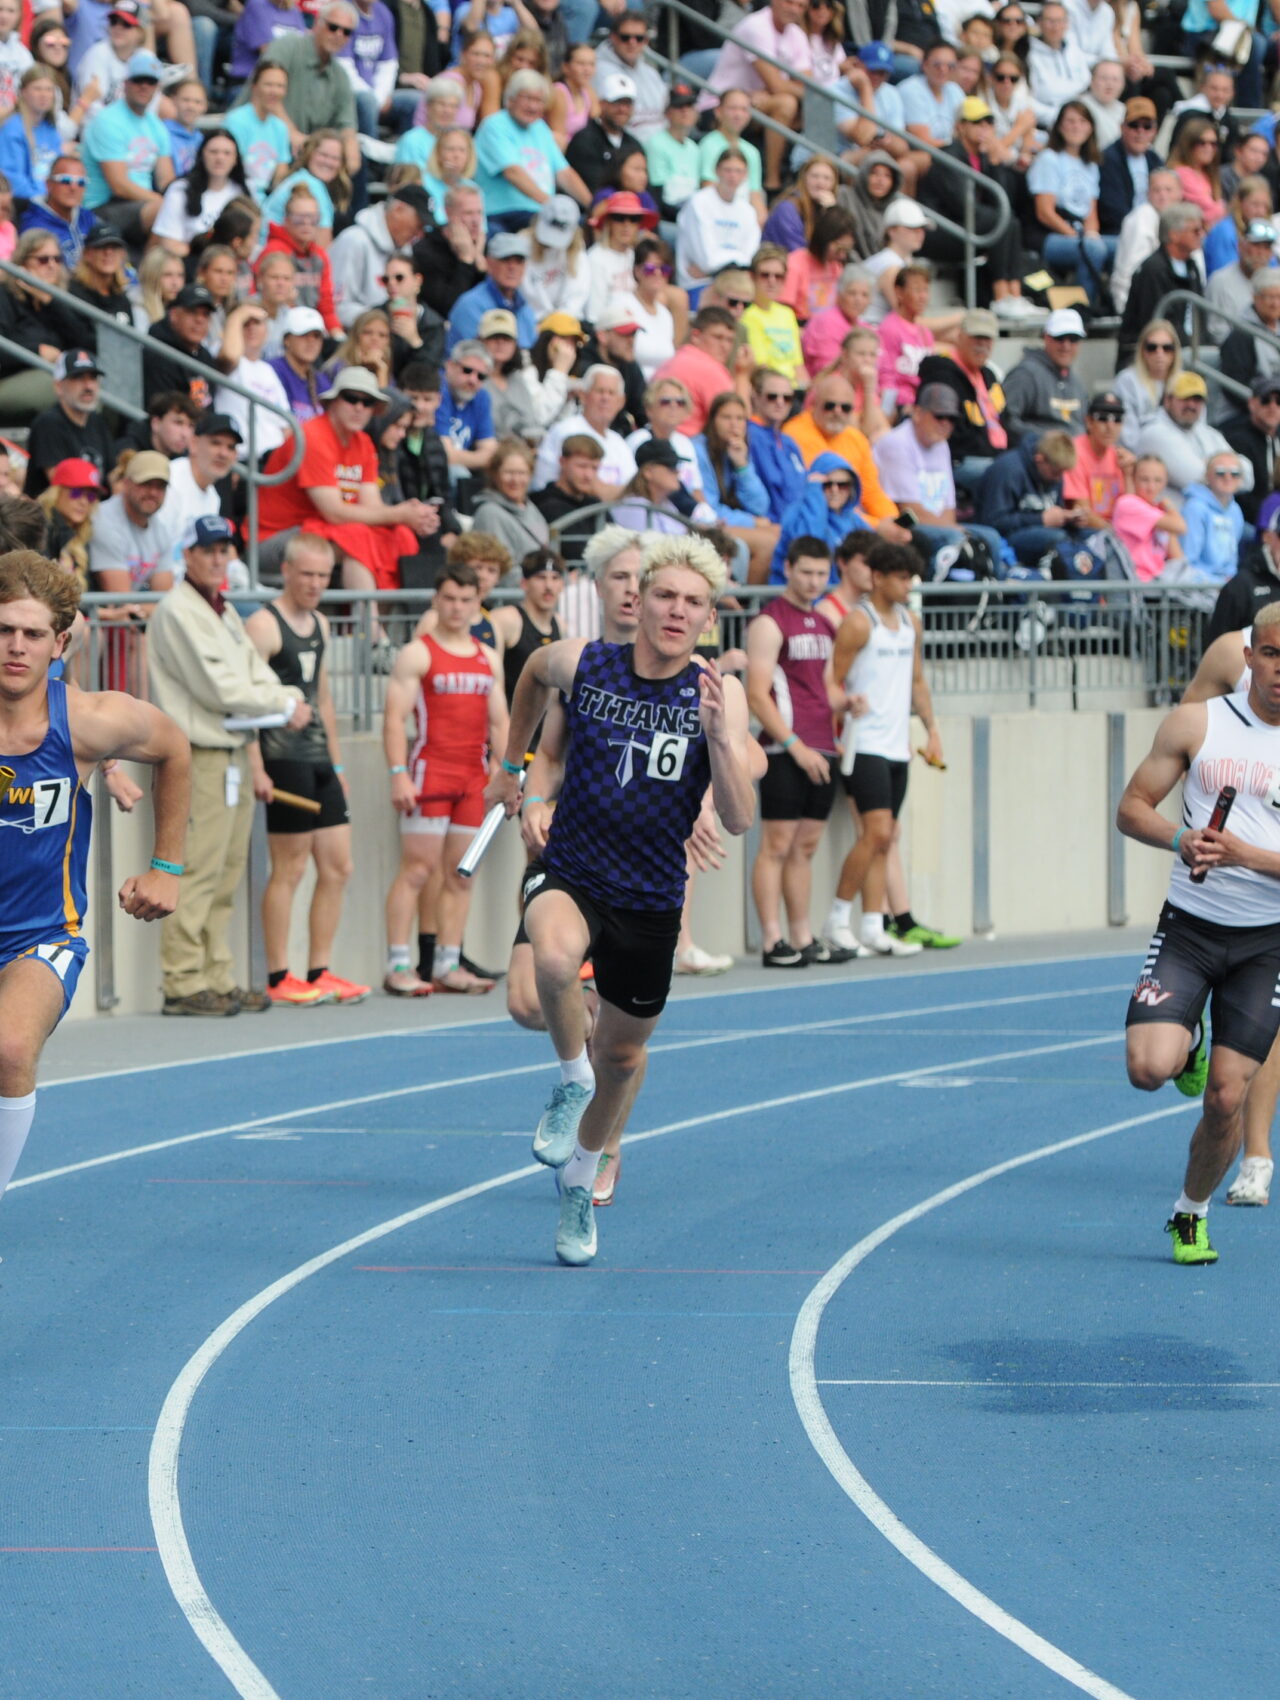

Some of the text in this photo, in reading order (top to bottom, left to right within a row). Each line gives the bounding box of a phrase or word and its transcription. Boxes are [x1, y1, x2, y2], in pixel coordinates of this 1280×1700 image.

[577, 683, 702, 738] TITANS
[656, 737, 679, 777] 6
[40, 782, 61, 825] 7
